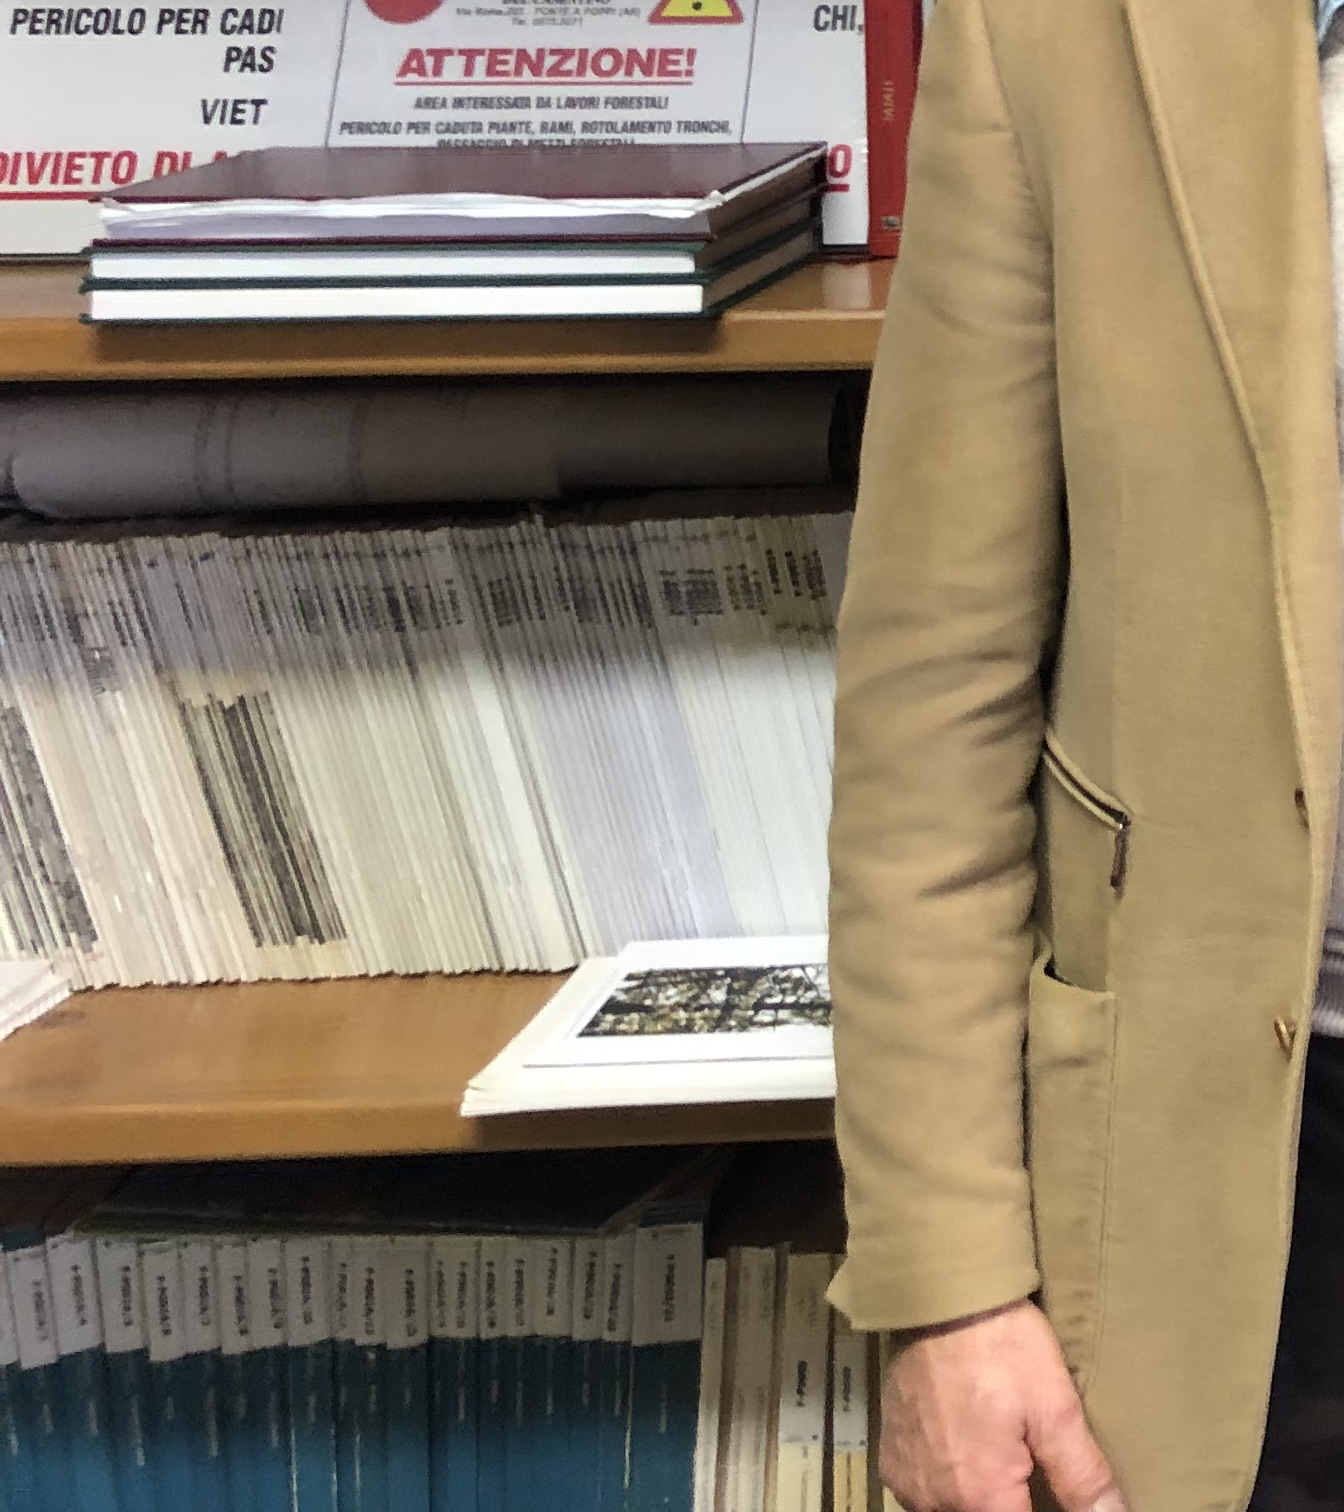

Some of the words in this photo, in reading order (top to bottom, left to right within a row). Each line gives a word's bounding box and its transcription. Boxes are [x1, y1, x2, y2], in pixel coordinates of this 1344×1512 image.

[9, 8, 148, 36] PERICOLO
[155, 8, 210, 36] PER
[396, 46, 698, 79] ATTENZIONE!
[413, 96, 449, 111] AREA
[535, 96, 553, 111] DA
[604, 96, 670, 111] FORESTALI
[340, 120, 403, 136] PERICOLO
[406, 120, 431, 136] PER
